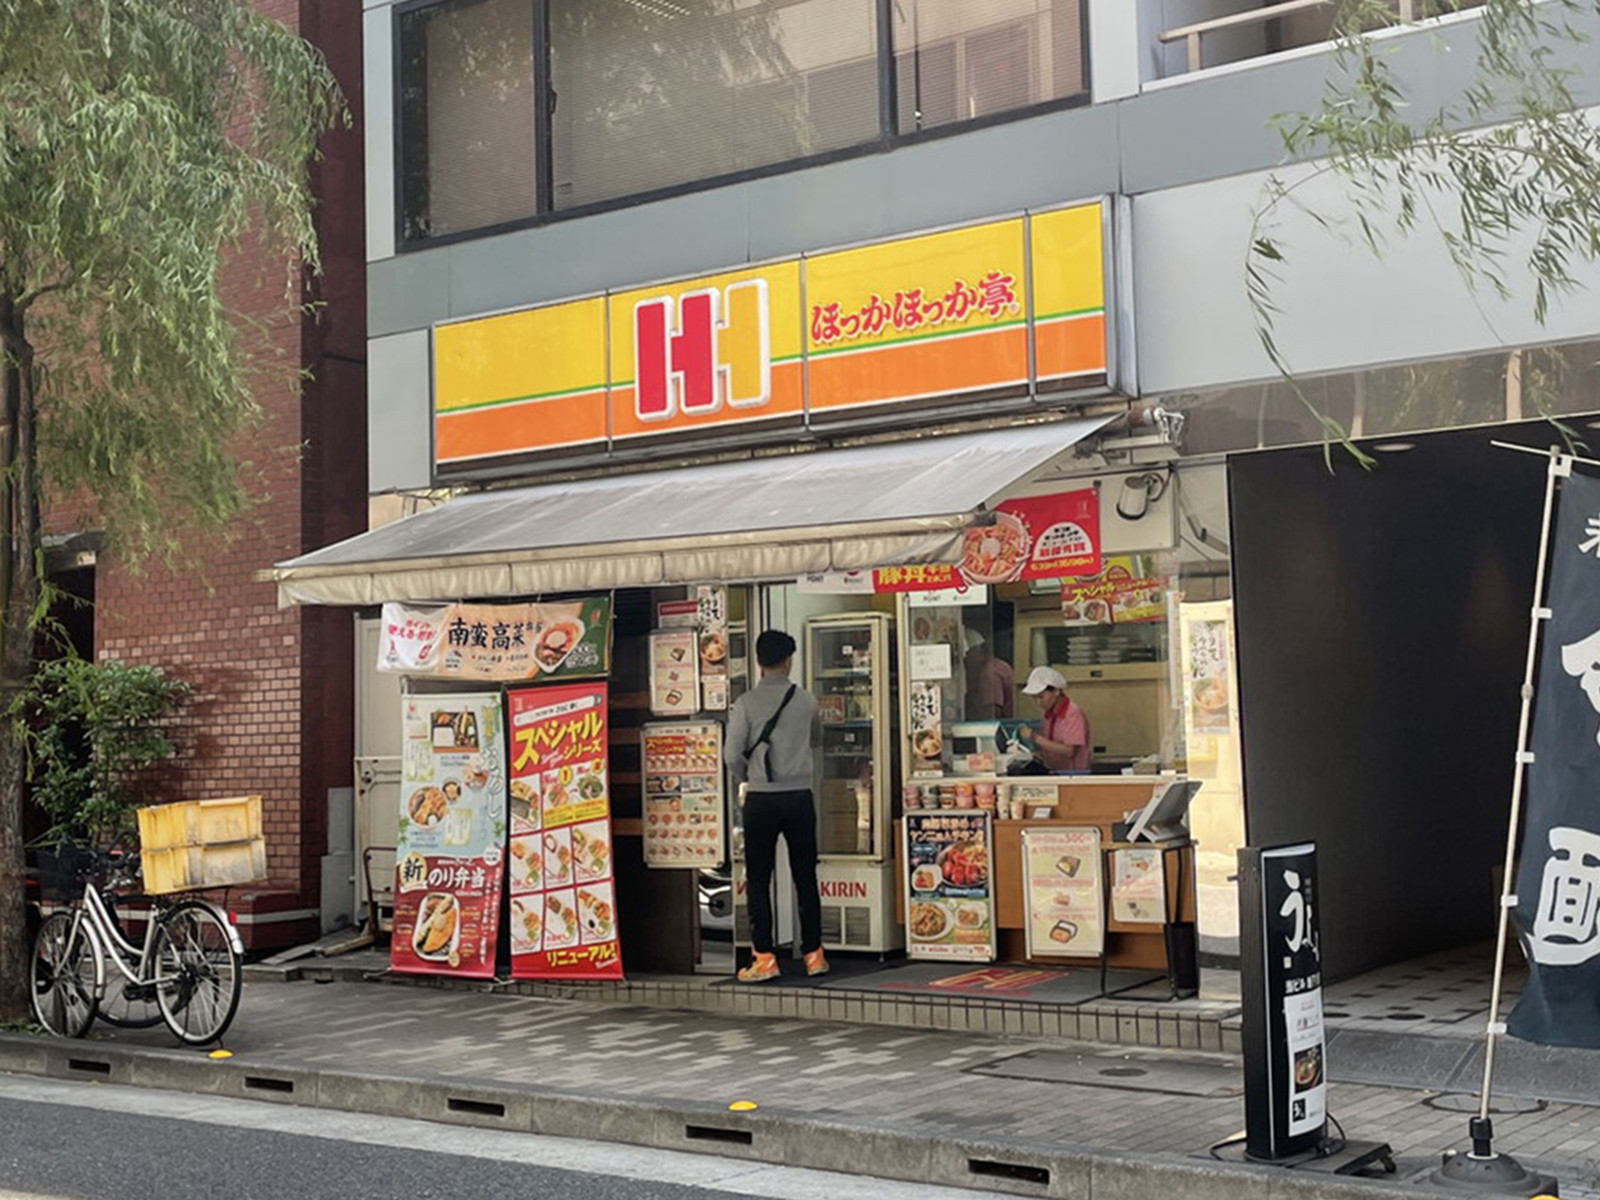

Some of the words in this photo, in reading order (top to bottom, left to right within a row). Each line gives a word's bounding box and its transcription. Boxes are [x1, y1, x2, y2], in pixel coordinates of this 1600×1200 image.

[811, 272, 1014, 341] ほっかほっか亭
[513, 711, 603, 771] スペシャル
[562, 738, 603, 760] シリーズ
[403, 856, 424, 882] 新
[428, 866, 485, 889] のり弁当
[820, 881, 867, 897] KIRIN
